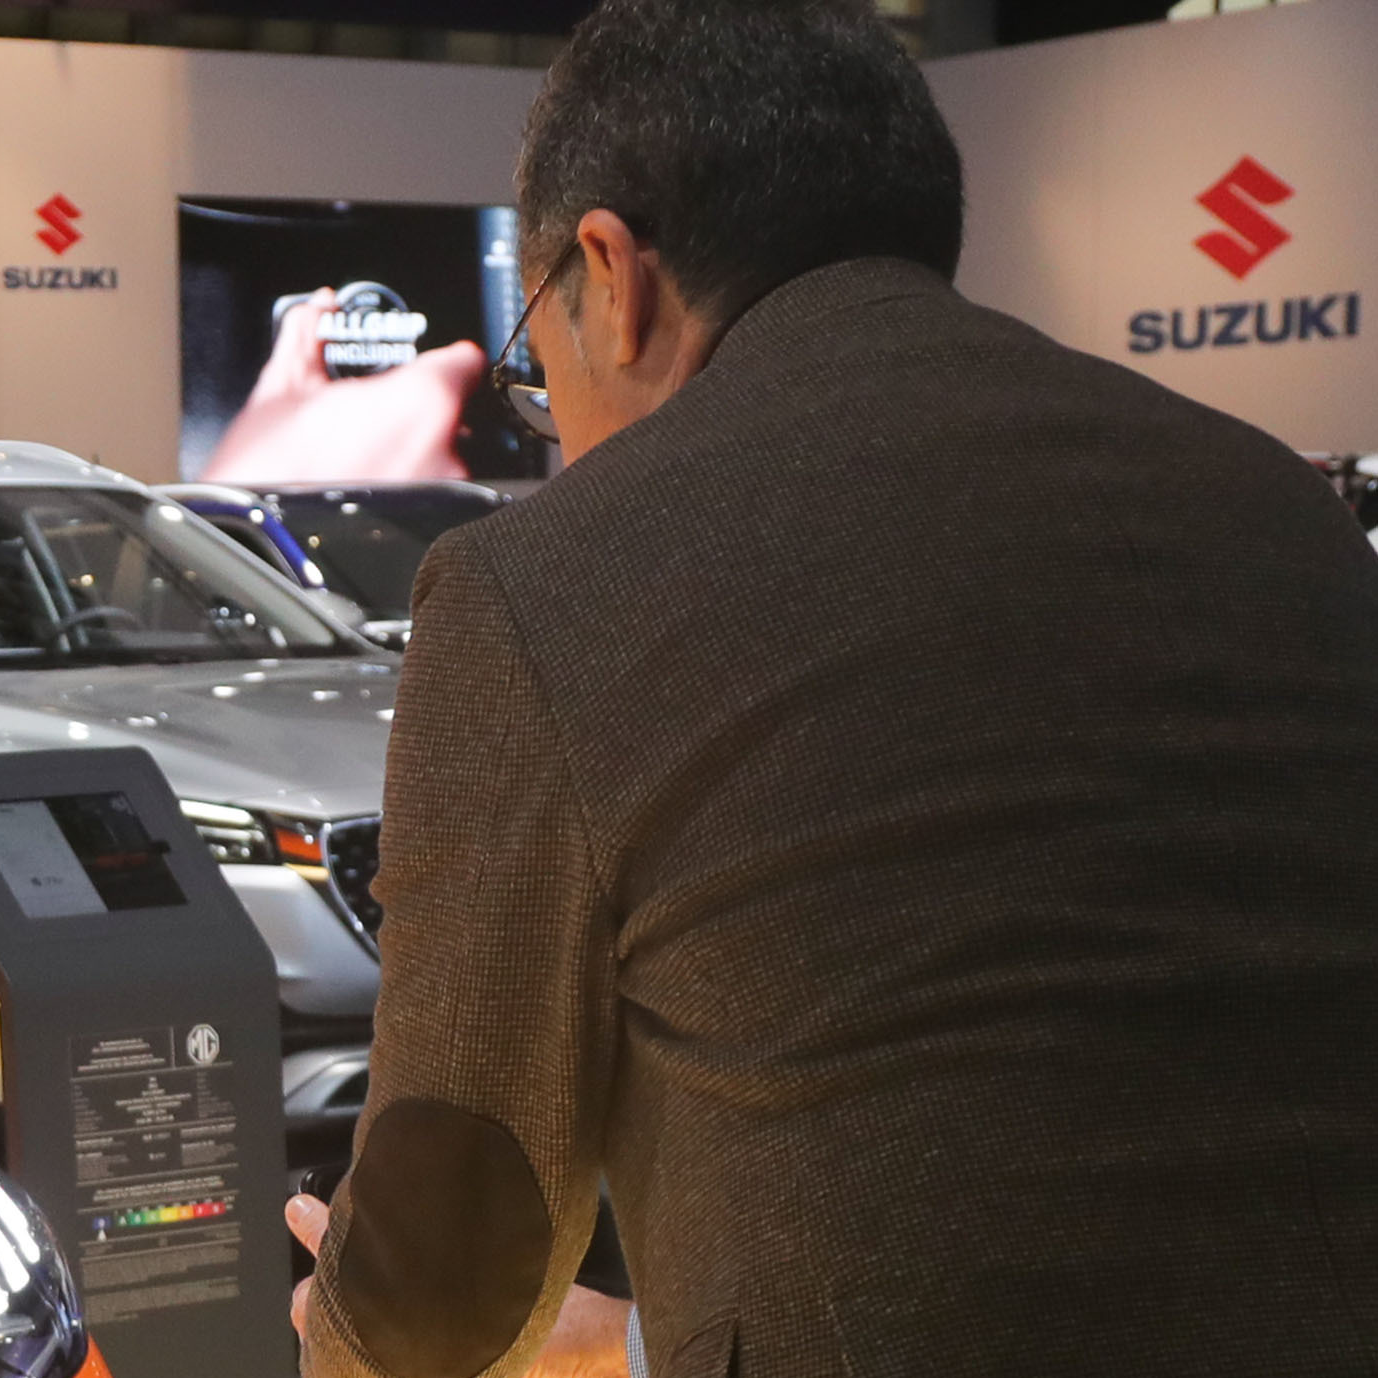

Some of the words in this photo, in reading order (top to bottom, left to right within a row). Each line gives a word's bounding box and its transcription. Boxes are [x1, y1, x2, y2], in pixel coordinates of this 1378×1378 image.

[2, 266, 118, 290] SUZUKI
[1127, 291, 1361, 355] SUZUKI
[189, 1025, 219, 1064] MG
